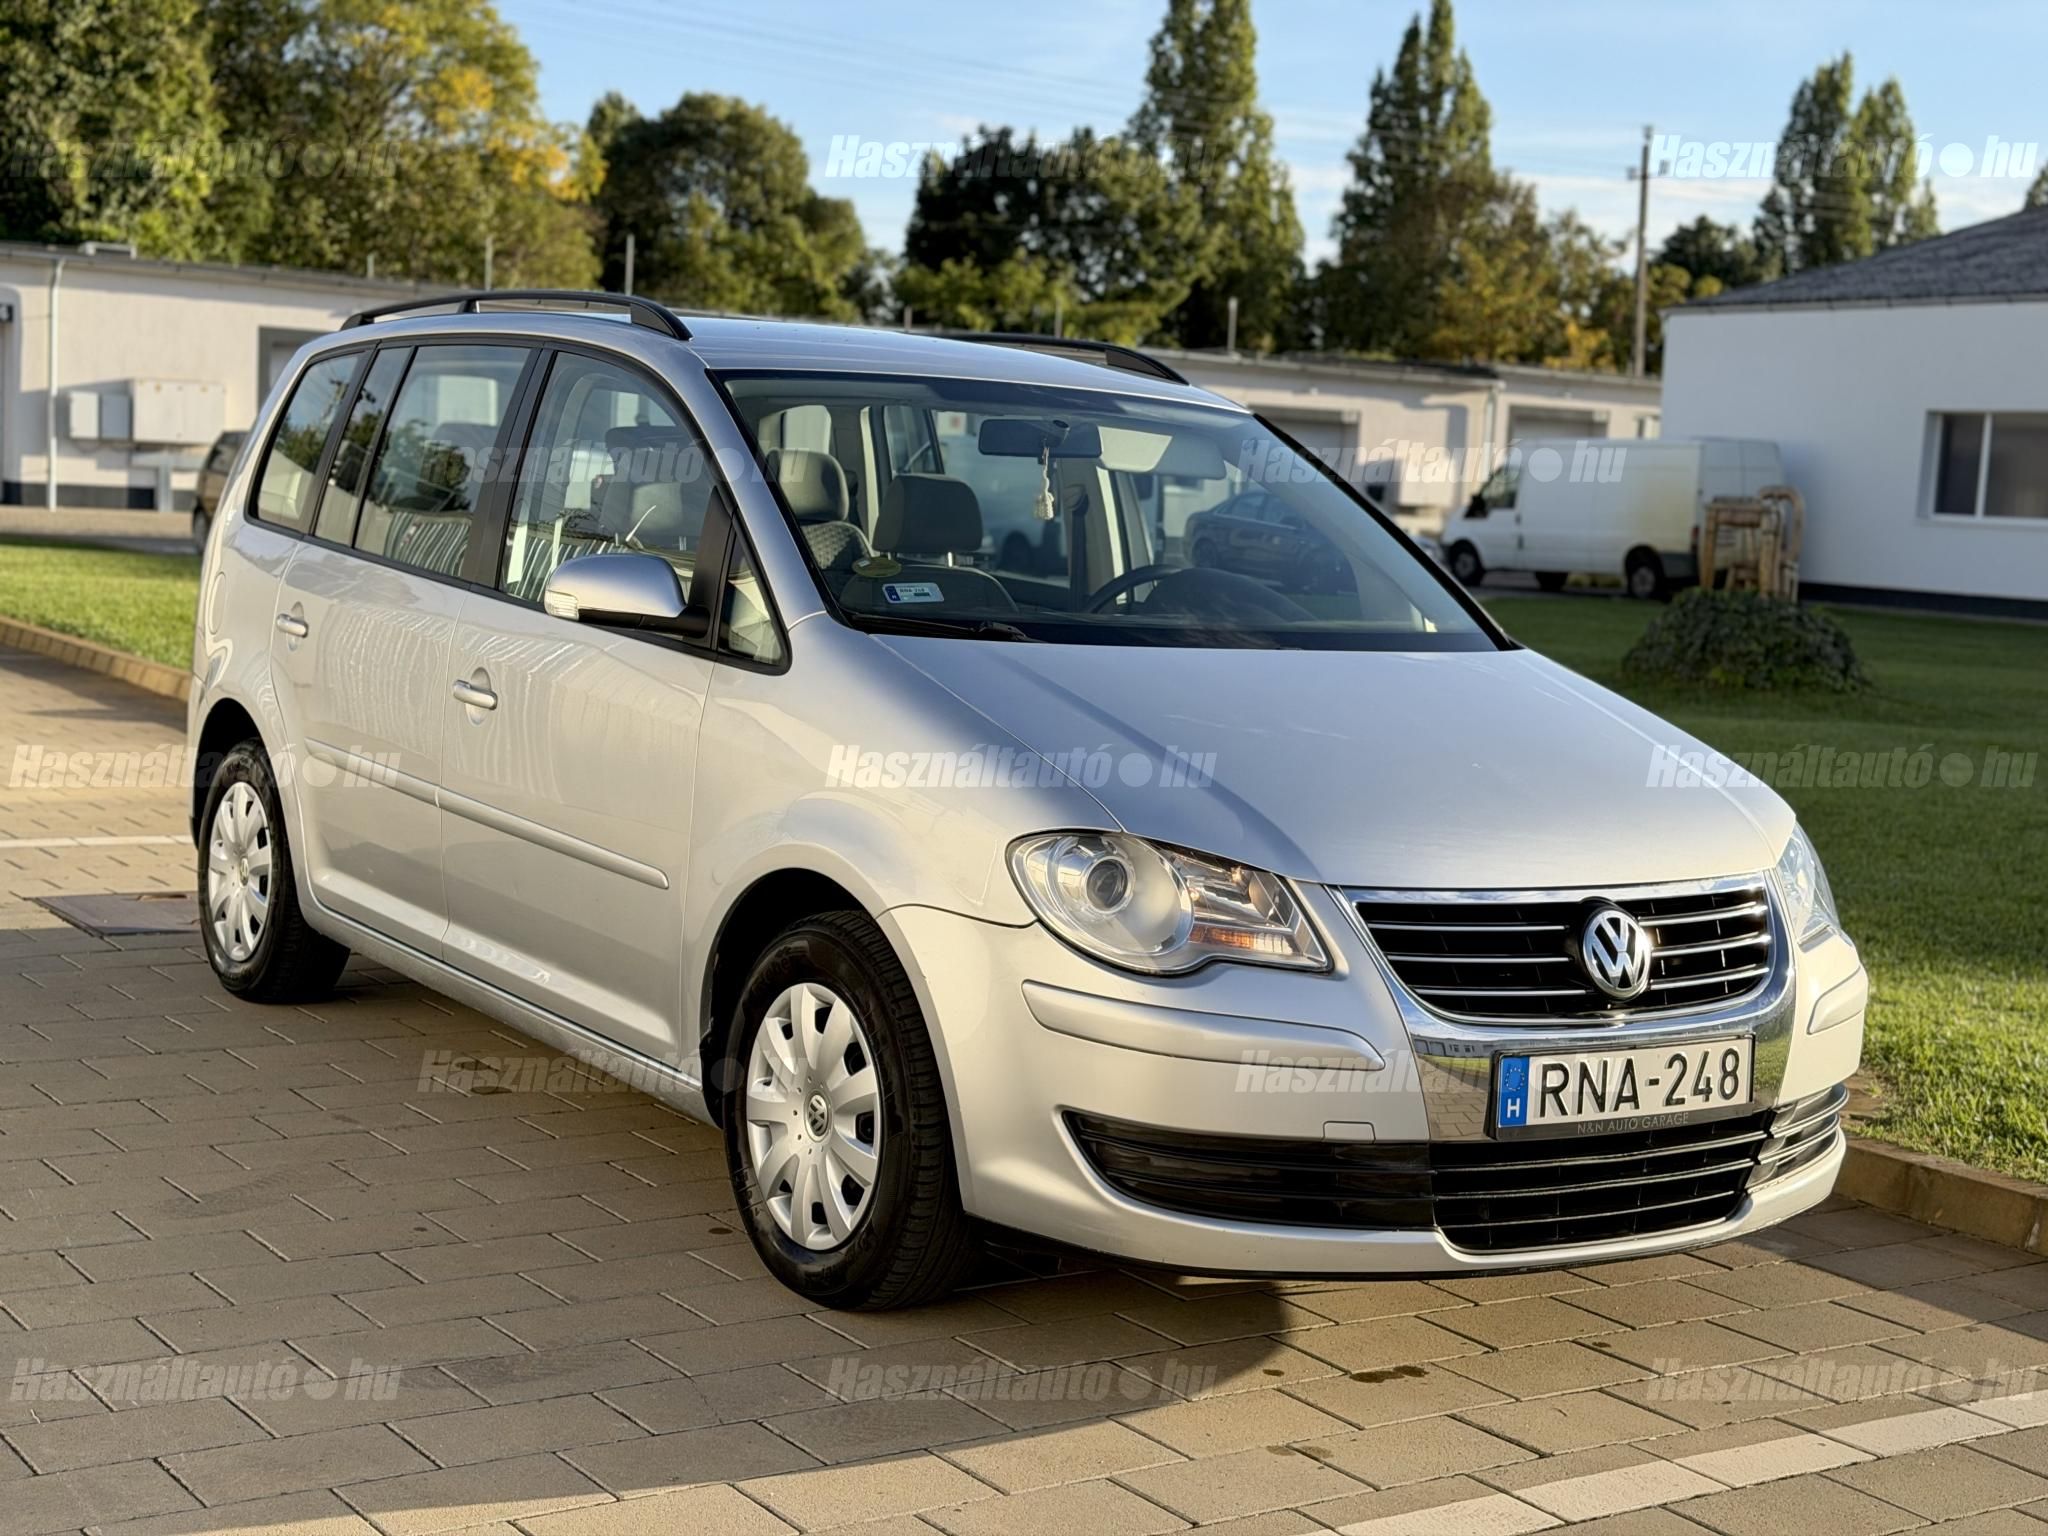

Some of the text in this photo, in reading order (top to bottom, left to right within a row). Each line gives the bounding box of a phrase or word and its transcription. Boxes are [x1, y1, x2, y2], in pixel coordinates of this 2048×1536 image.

[1540, 1047, 1740, 1118] RNA-248
[1506, 1097, 1521, 1119] H
[1577, 1111, 1690, 1135] N&N AUTO GARAGE
